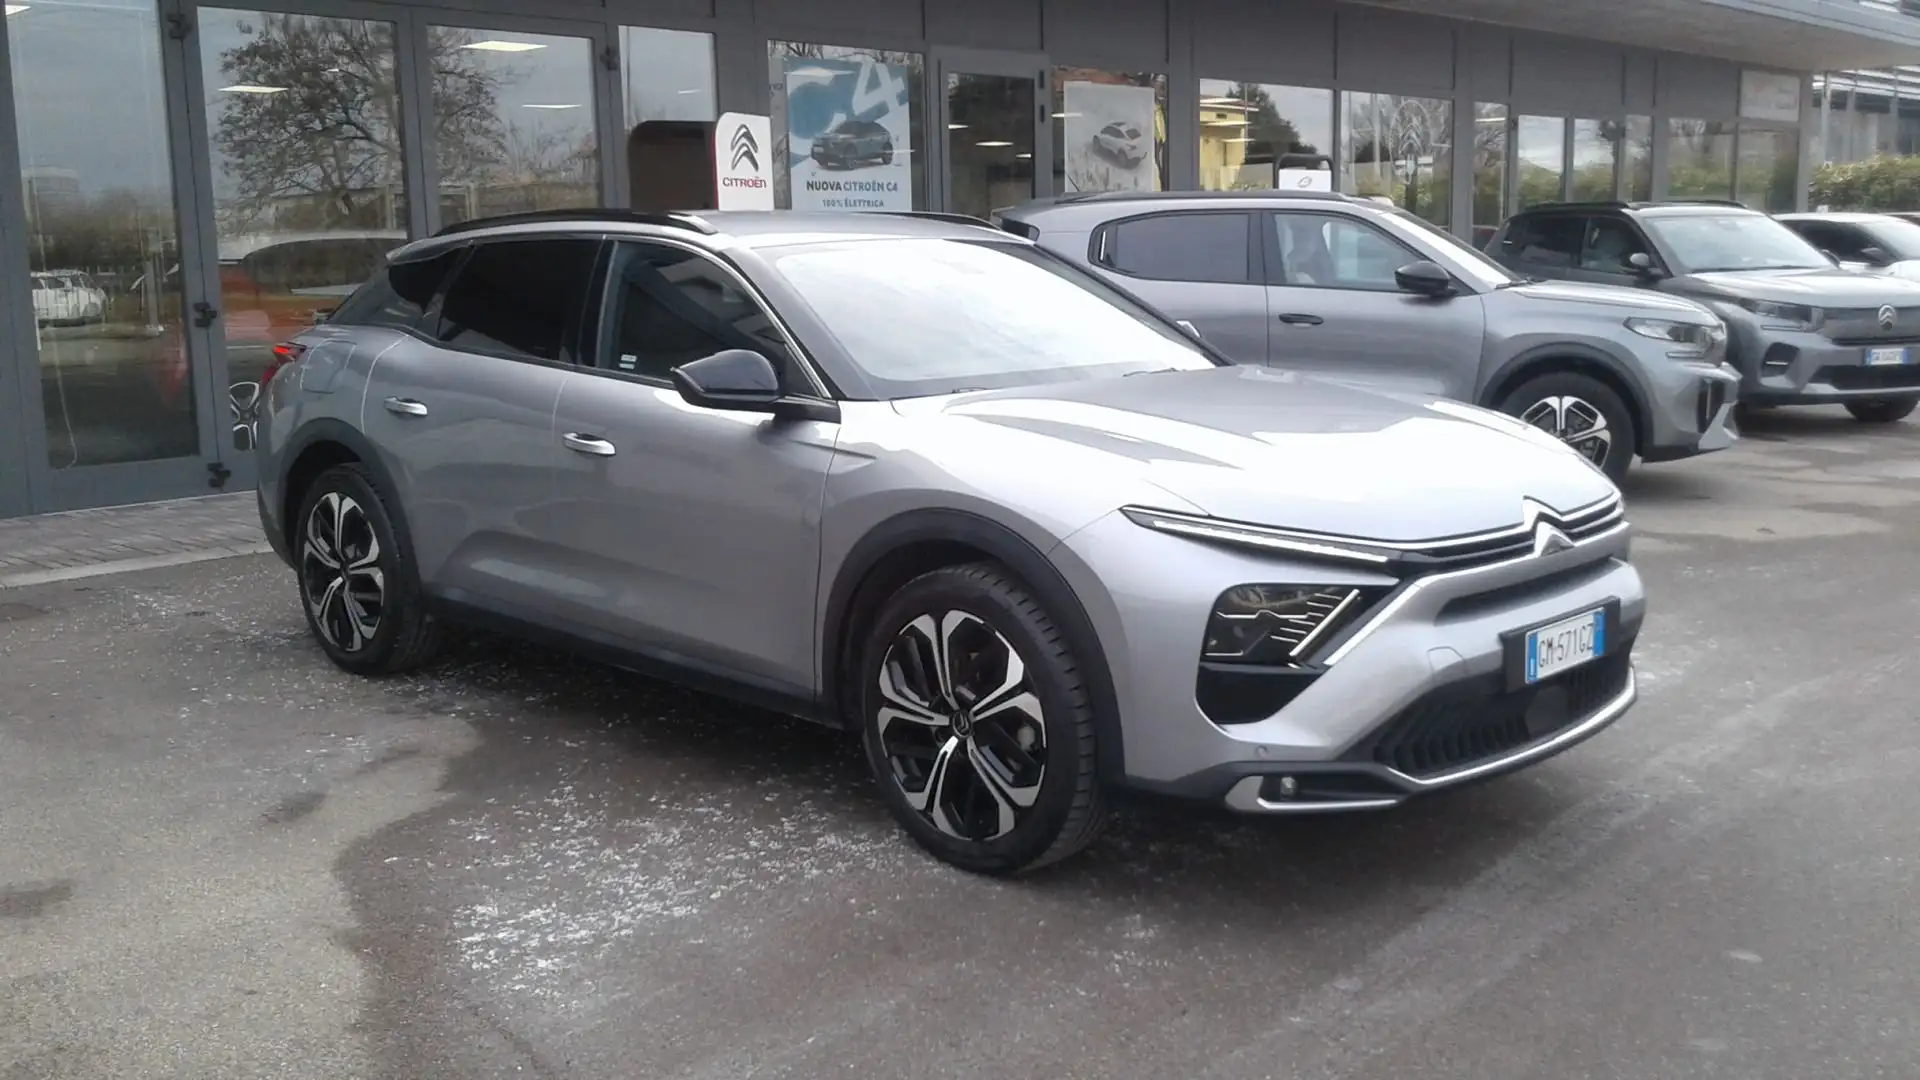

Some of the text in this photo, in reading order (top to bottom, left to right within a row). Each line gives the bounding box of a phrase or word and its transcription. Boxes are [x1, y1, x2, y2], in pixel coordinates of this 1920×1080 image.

[806, 180, 898, 192] NUOVA CITROËN C4
